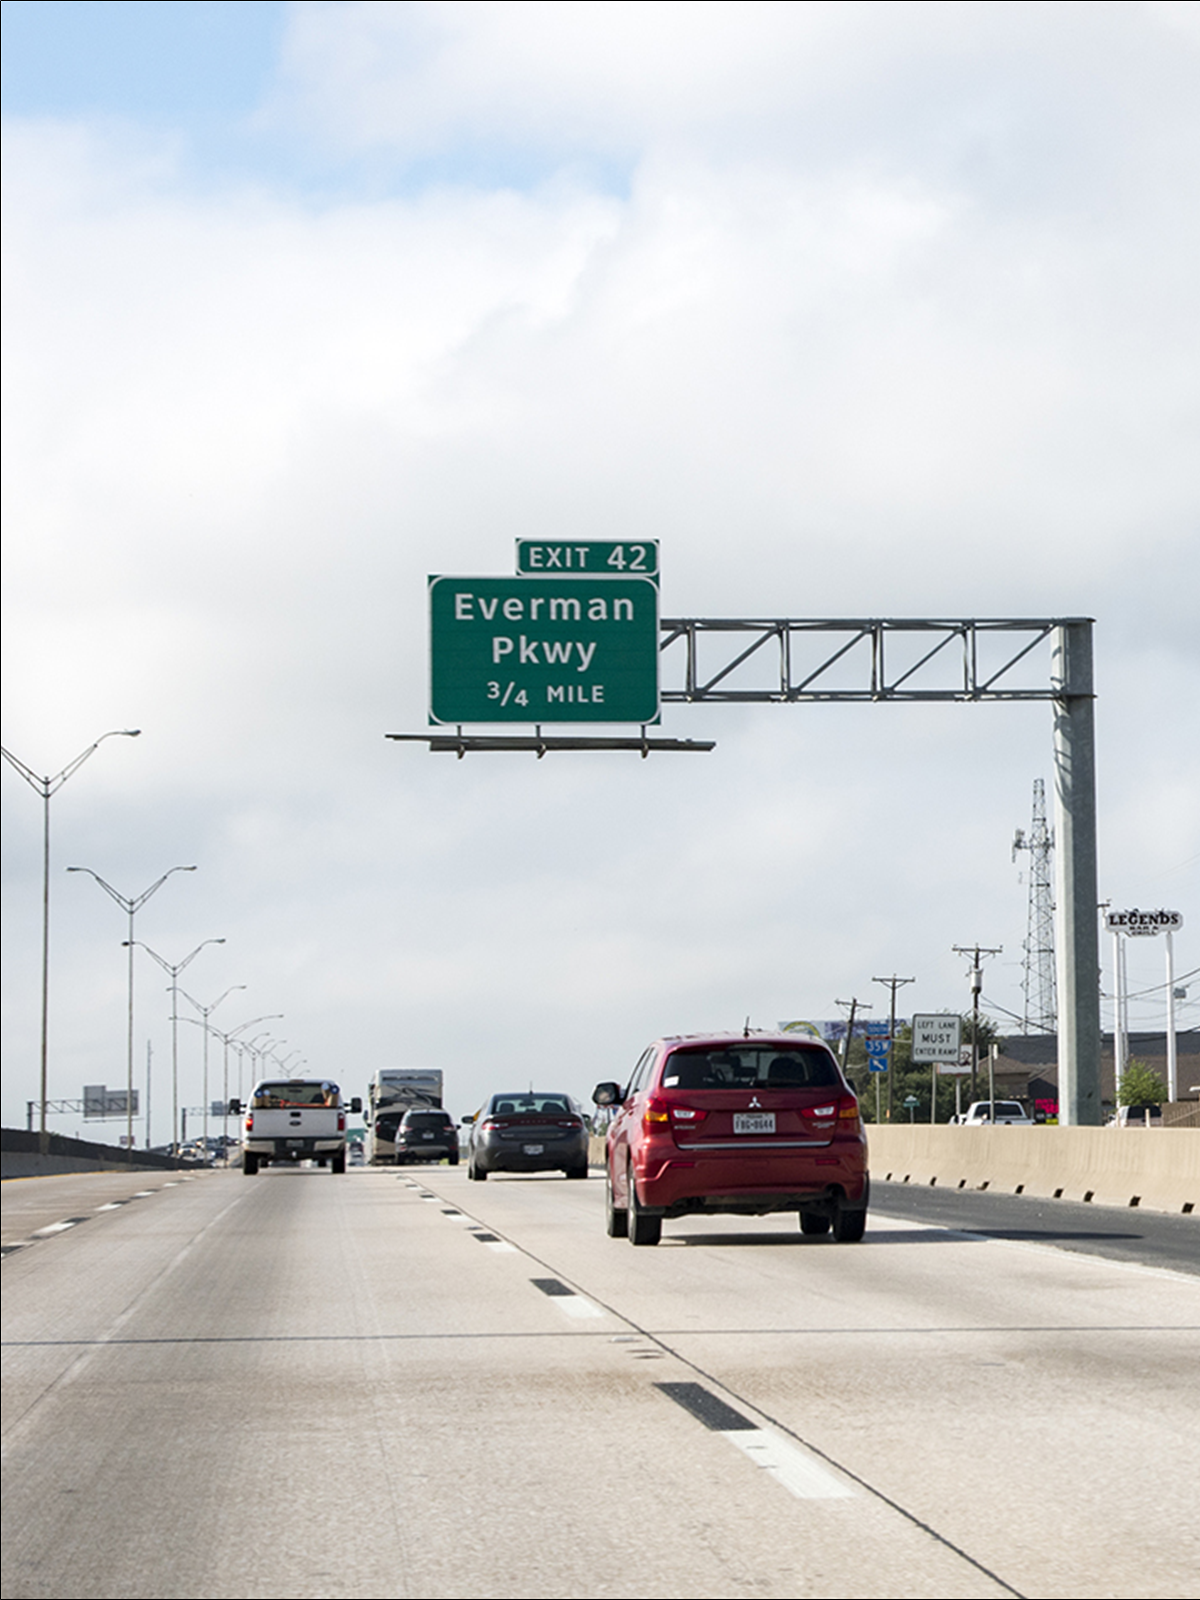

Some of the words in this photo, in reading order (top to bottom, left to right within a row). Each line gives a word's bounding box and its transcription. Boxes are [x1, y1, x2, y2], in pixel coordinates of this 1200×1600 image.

[529, 547, 590, 568] EXIT
[607, 545, 647, 571] 42
[454, 593, 635, 621] Everman
[492, 635, 597, 672] Pkwy
[486, 681, 529, 707] 3/4
[546, 685, 605, 703] MILE
[1108, 912, 1179, 926] LEGENDS
[917, 1021, 934, 1029] LEFT
[938, 1021, 957, 1029] LANE
[921, 1033, 951, 1044] MUST
[868, 1040, 890, 1052] 35W
[915, 1048, 936, 1056] ENTER
[938, 1048, 957, 1056] RAMP
